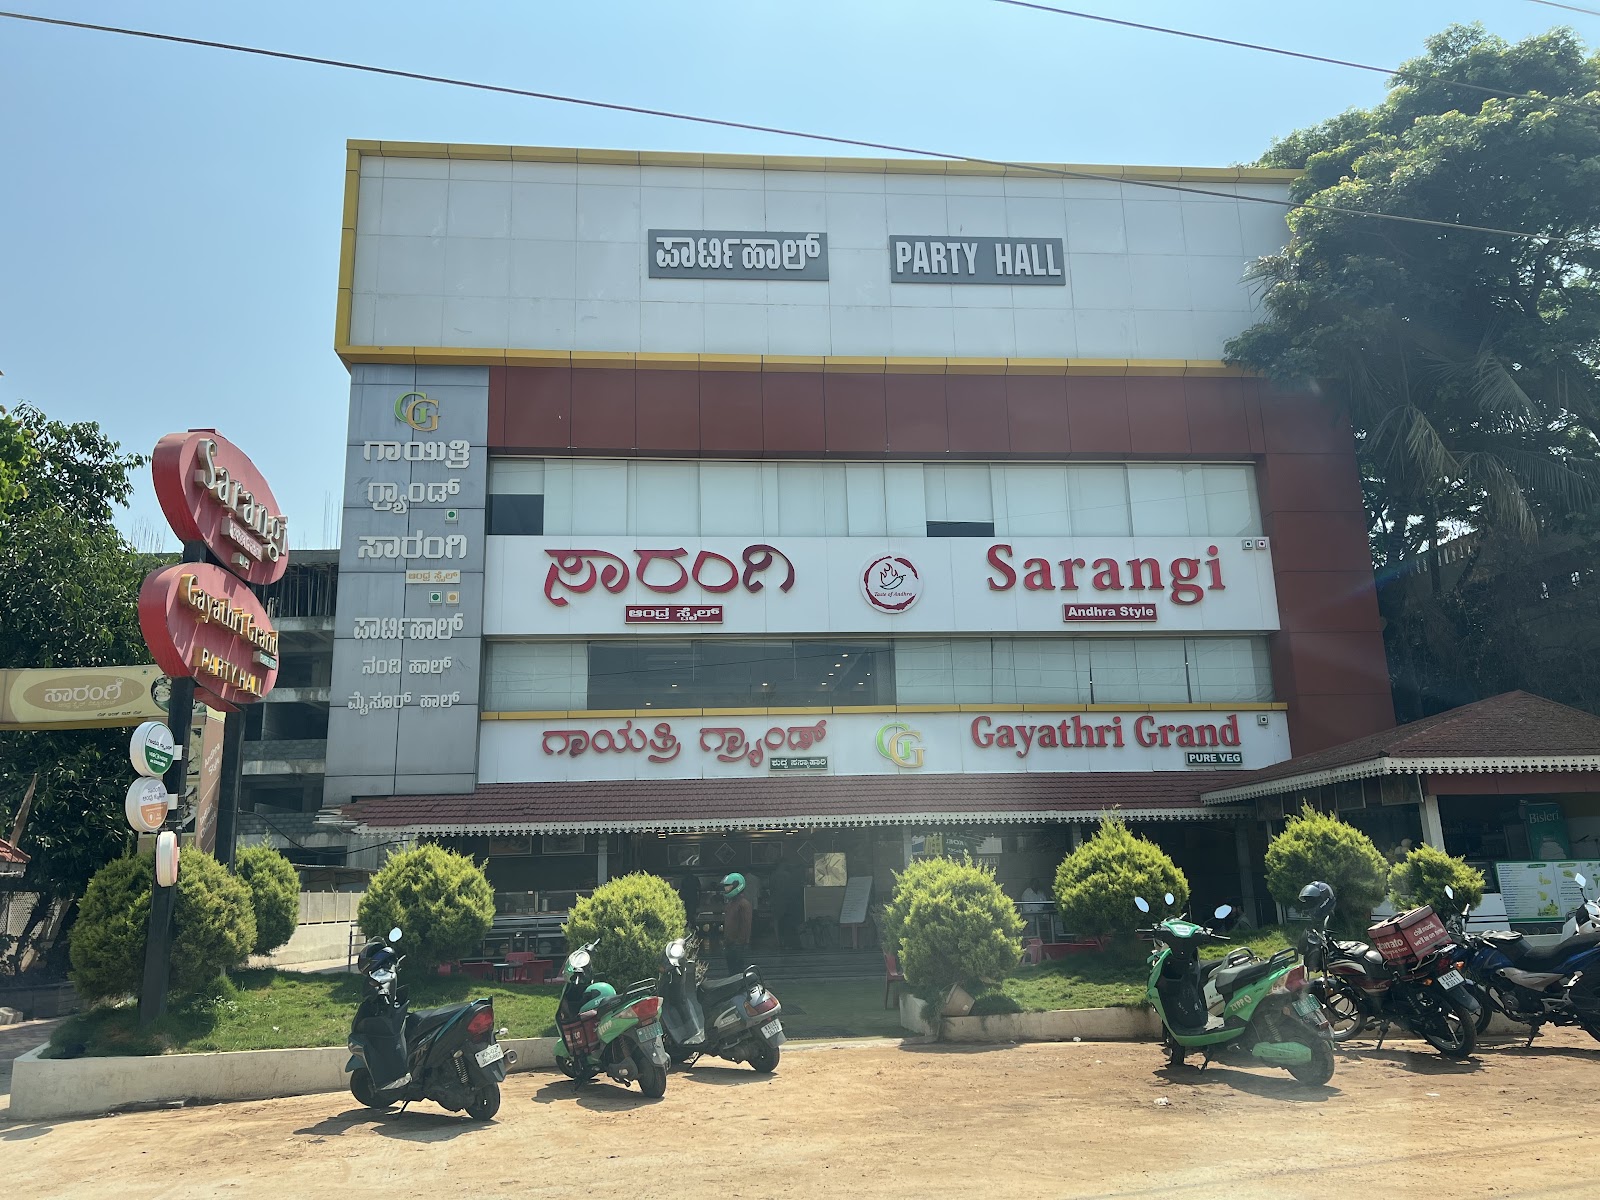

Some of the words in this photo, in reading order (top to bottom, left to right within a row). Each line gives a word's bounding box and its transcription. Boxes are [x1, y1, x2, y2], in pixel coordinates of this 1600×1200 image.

[895, 241, 978, 275] PARTY
[995, 243, 1062, 277] HALL
[198, 438, 288, 563] Sarangi
[358, 529, 468, 560] ಸಾರಂಗಿ
[544, 543, 796, 607] ಸಾರಂಗಿ
[986, 543, 1227, 606] Sarangi
[182, 574, 244, 636] Gayathri
[241, 612, 279, 657] Grand
[1067, 605, 1116, 618] Andhra
[1119, 606, 1155, 619] Style
[201, 647, 238, 684] PARTY
[238, 668, 263, 698] HALL
[362, 655, 402, 675] ನಂದಿ
[408, 656, 452, 675] ಹಾಲ್
[347, 691, 412, 716] ಮೈಸೂರ್
[419, 691, 460, 708] ಹಾಲ್
[970, 715, 1126, 759] Gayathri
[1133, 713, 1242, 748] Grand
[1188, 753, 1218, 764] PURE
[1219, 753, 1242, 764] VEG
[1529, 810, 1560, 824] Bisleri
